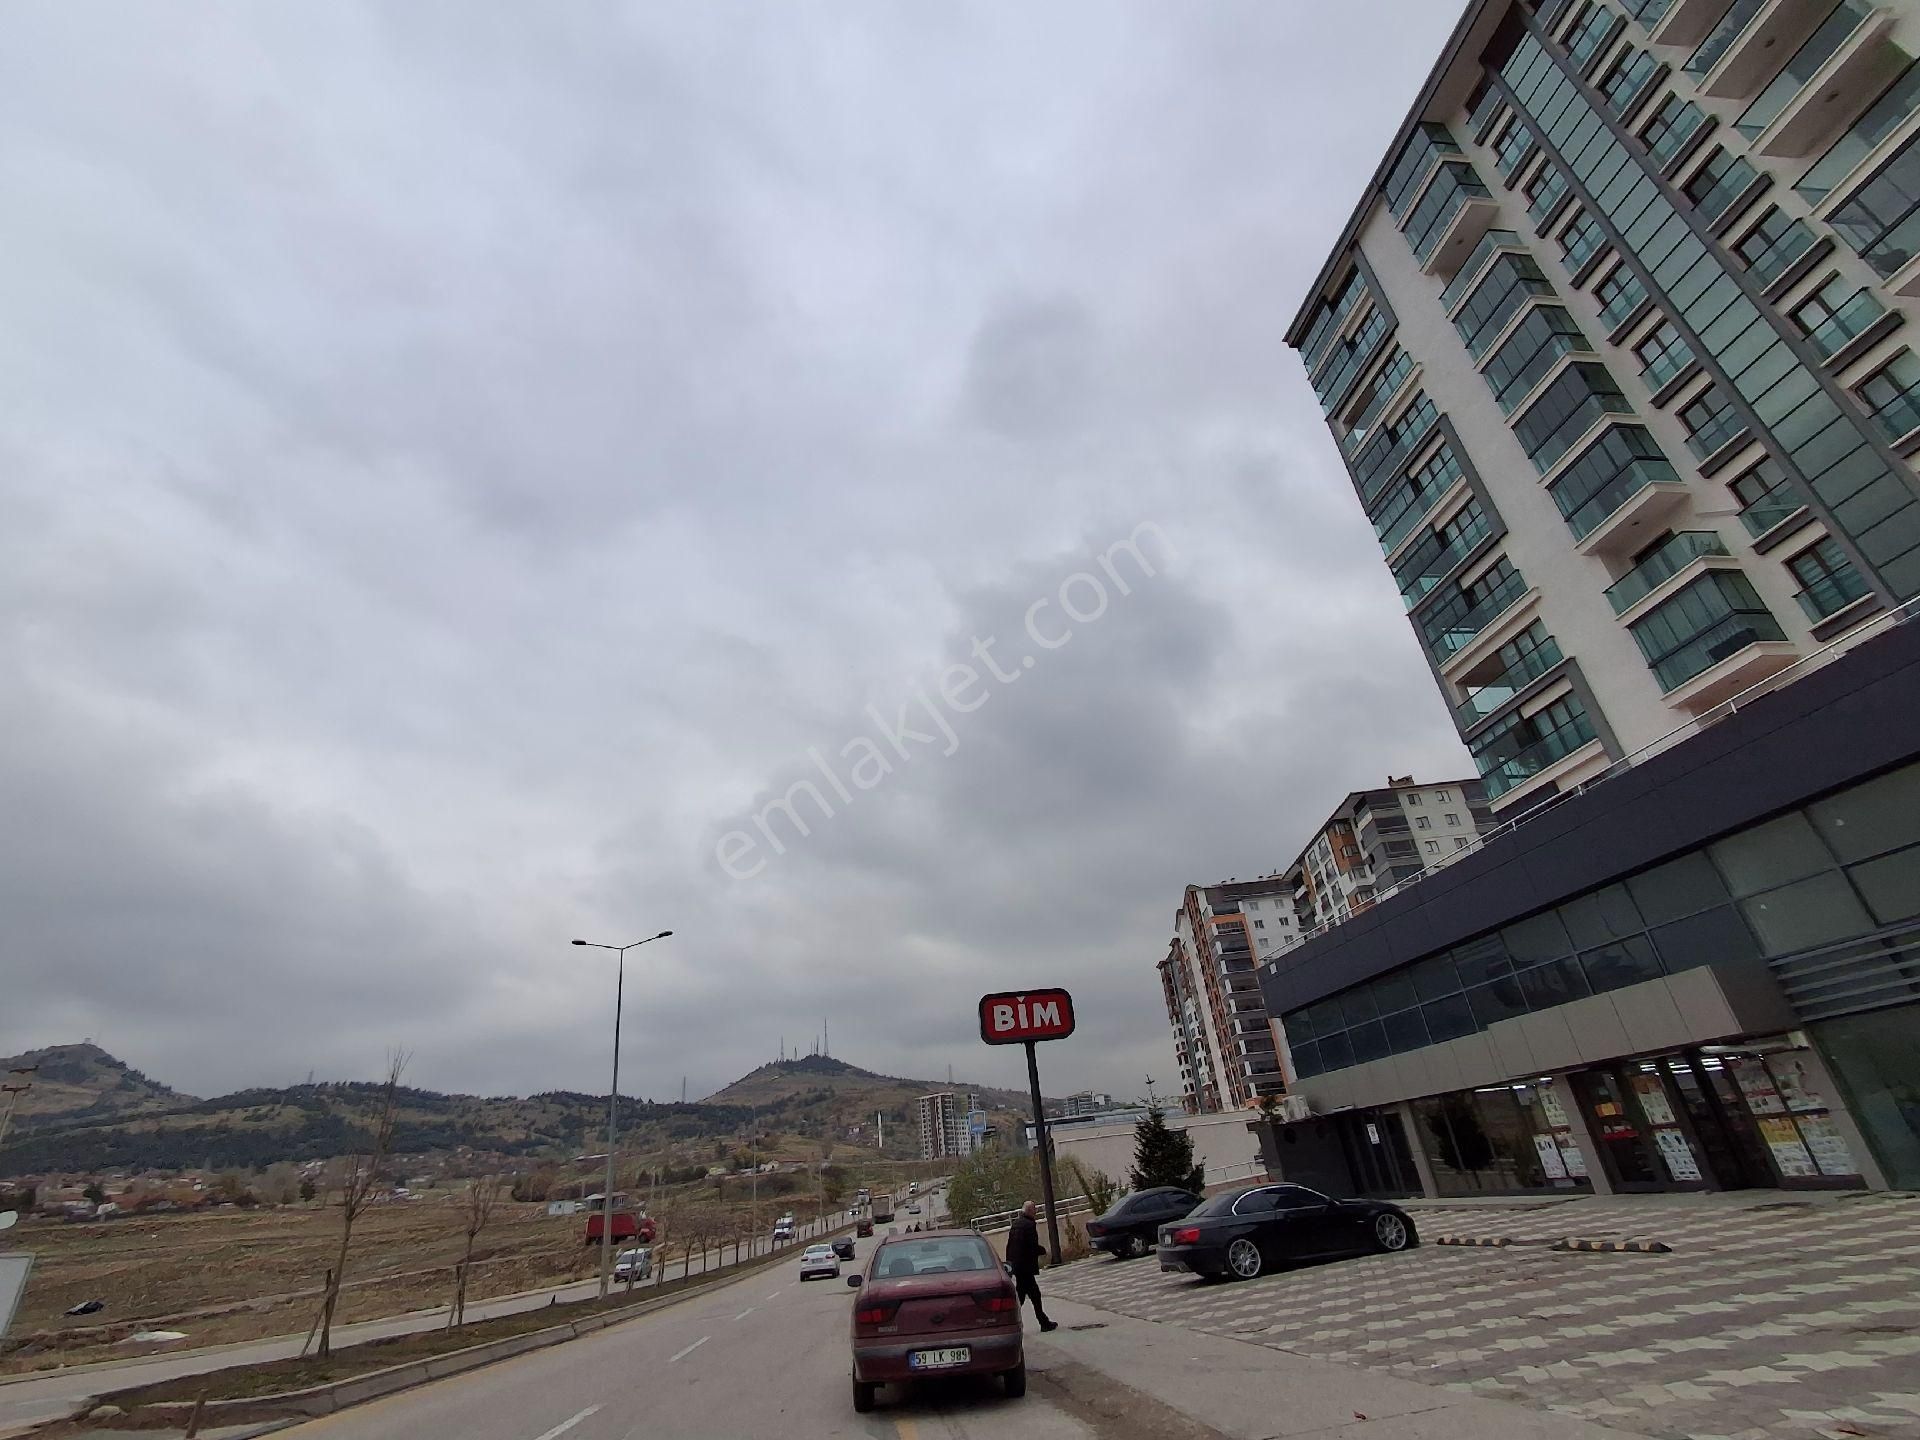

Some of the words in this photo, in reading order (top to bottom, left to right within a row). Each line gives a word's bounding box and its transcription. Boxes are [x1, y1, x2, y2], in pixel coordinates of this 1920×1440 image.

[993, 996, 1062, 1032] BİM
[915, 1353, 927, 1364] 59
[933, 1351, 945, 1363] LK
